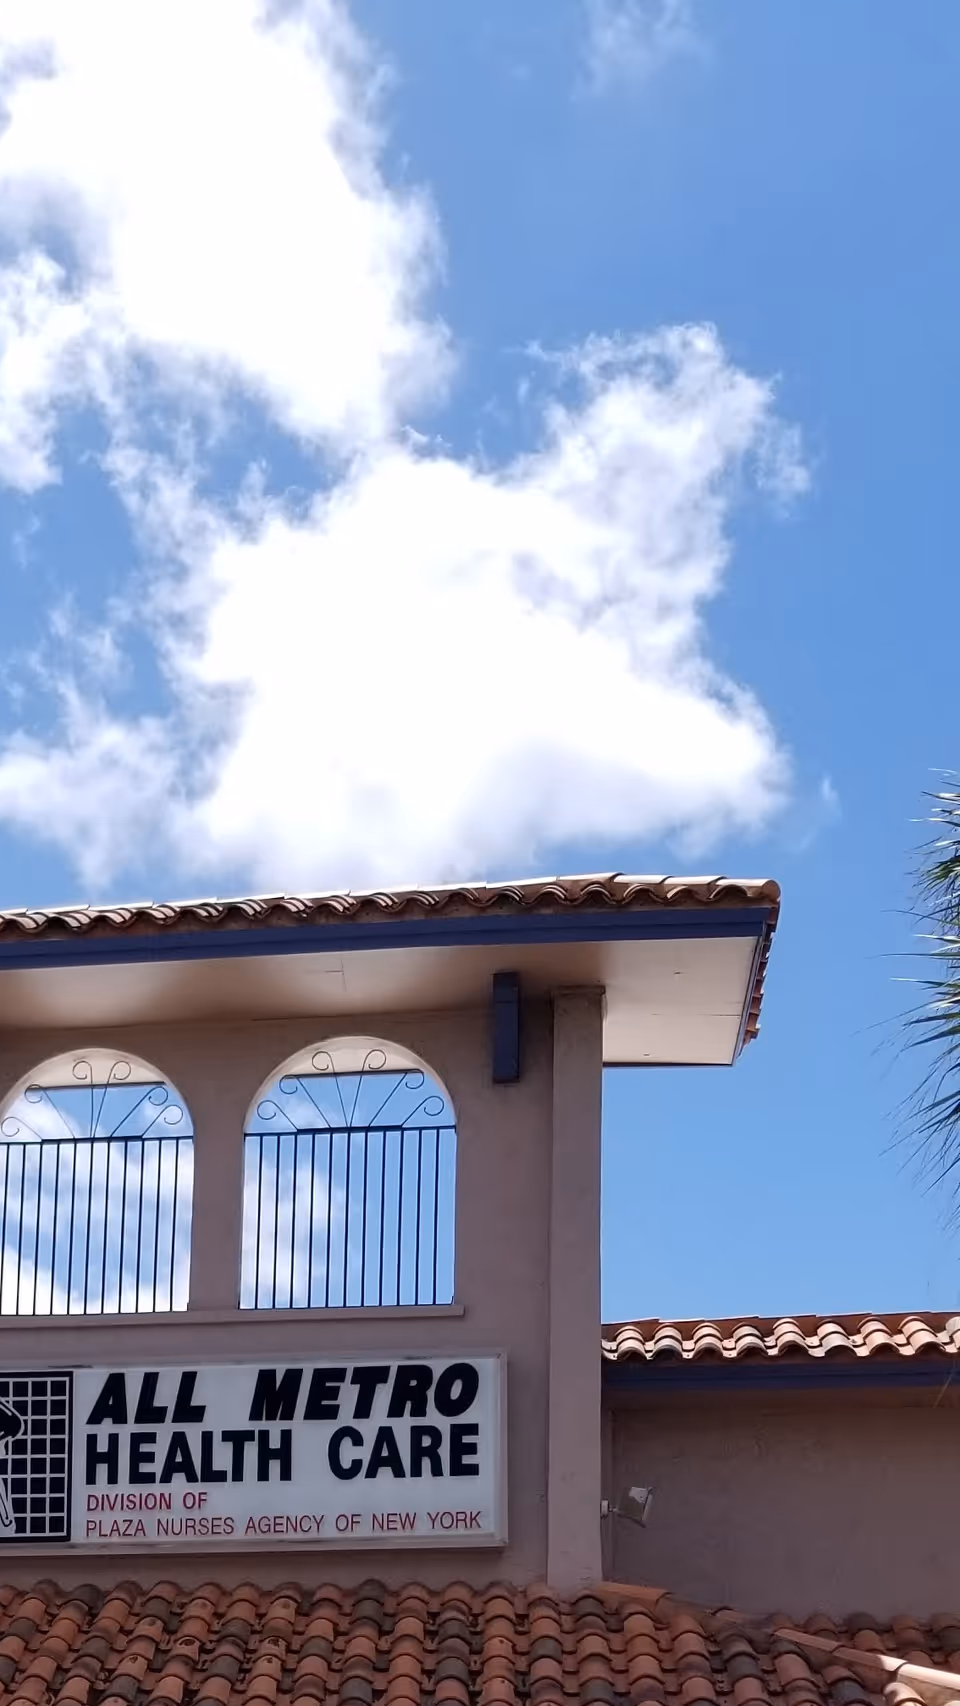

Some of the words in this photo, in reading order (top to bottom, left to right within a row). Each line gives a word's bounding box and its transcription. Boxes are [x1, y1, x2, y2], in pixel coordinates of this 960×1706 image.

[86, 1370, 207, 1425] ALL
[248, 1362, 480, 1422] METRO
[84, 1428, 292, 1485] HEALTH
[327, 1422, 481, 1481] CARE
[85, 1518, 147, 1537] PLAZA
[156, 1516, 235, 1536] NURSES
[244, 1514, 325, 1533] AGENCY
[335, 1513, 362, 1532] OF
[371, 1512, 418, 1531] NEW
[426, 1510, 483, 1529] YORK
[86, 1492, 172, 1512] DIVISION
[182, 1491, 208, 1511] OF
